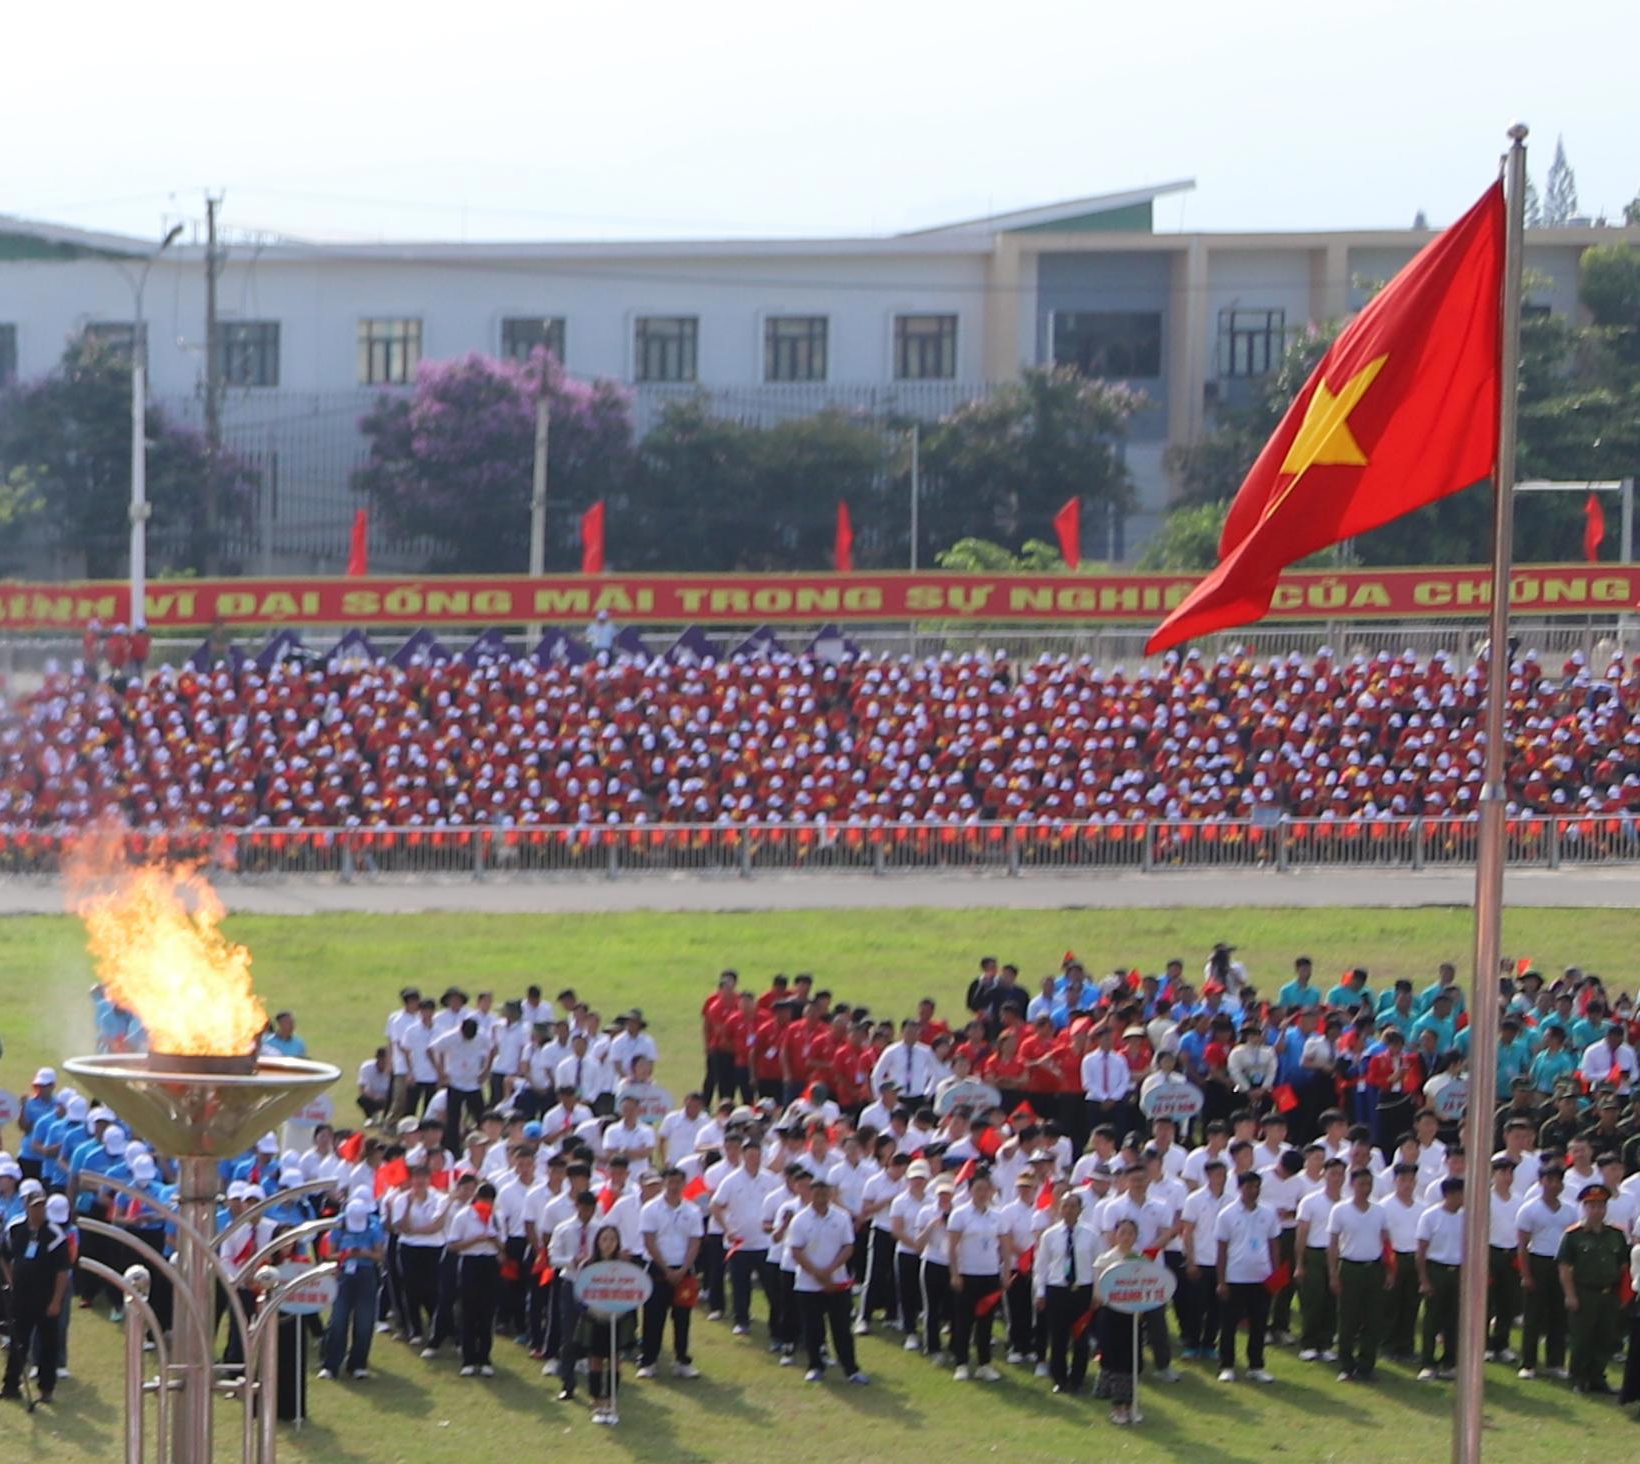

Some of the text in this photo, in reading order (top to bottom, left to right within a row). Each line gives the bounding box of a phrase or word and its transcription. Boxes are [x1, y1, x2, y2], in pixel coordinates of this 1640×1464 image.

[216, 591, 320, 620] ĐẠI
[341, 584, 512, 615] SỐNG
[534, 584, 654, 613] MÃI
[676, 587, 883, 612] TRONG
[907, 585, 995, 614] SỰ
[1272, 577, 1391, 608] CỦA
[1413, 576, 1630, 605] CHÚNG
